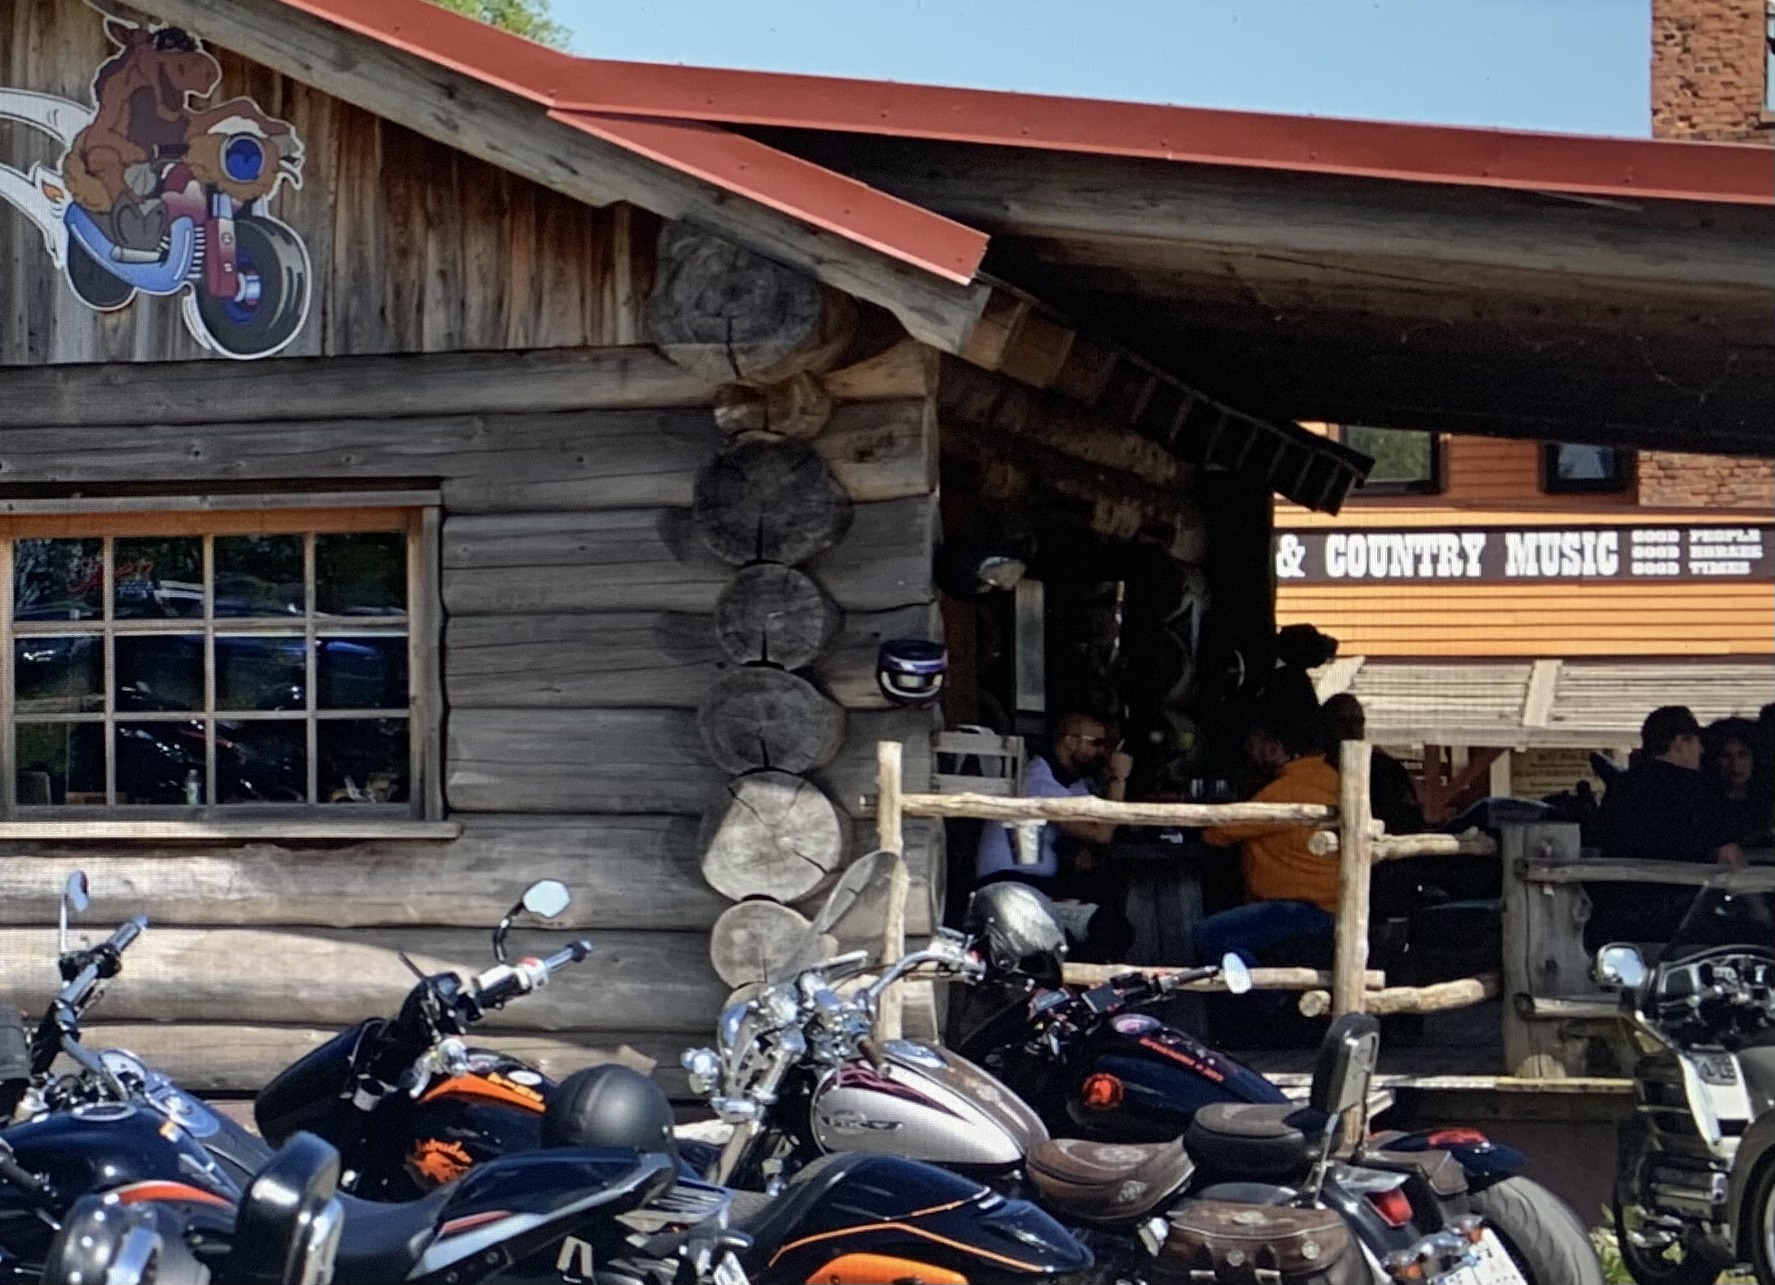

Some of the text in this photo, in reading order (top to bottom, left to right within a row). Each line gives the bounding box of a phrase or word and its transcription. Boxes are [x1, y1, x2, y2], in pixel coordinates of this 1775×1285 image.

[1276, 531, 1619, 577] & COUNTRY MUSIC
